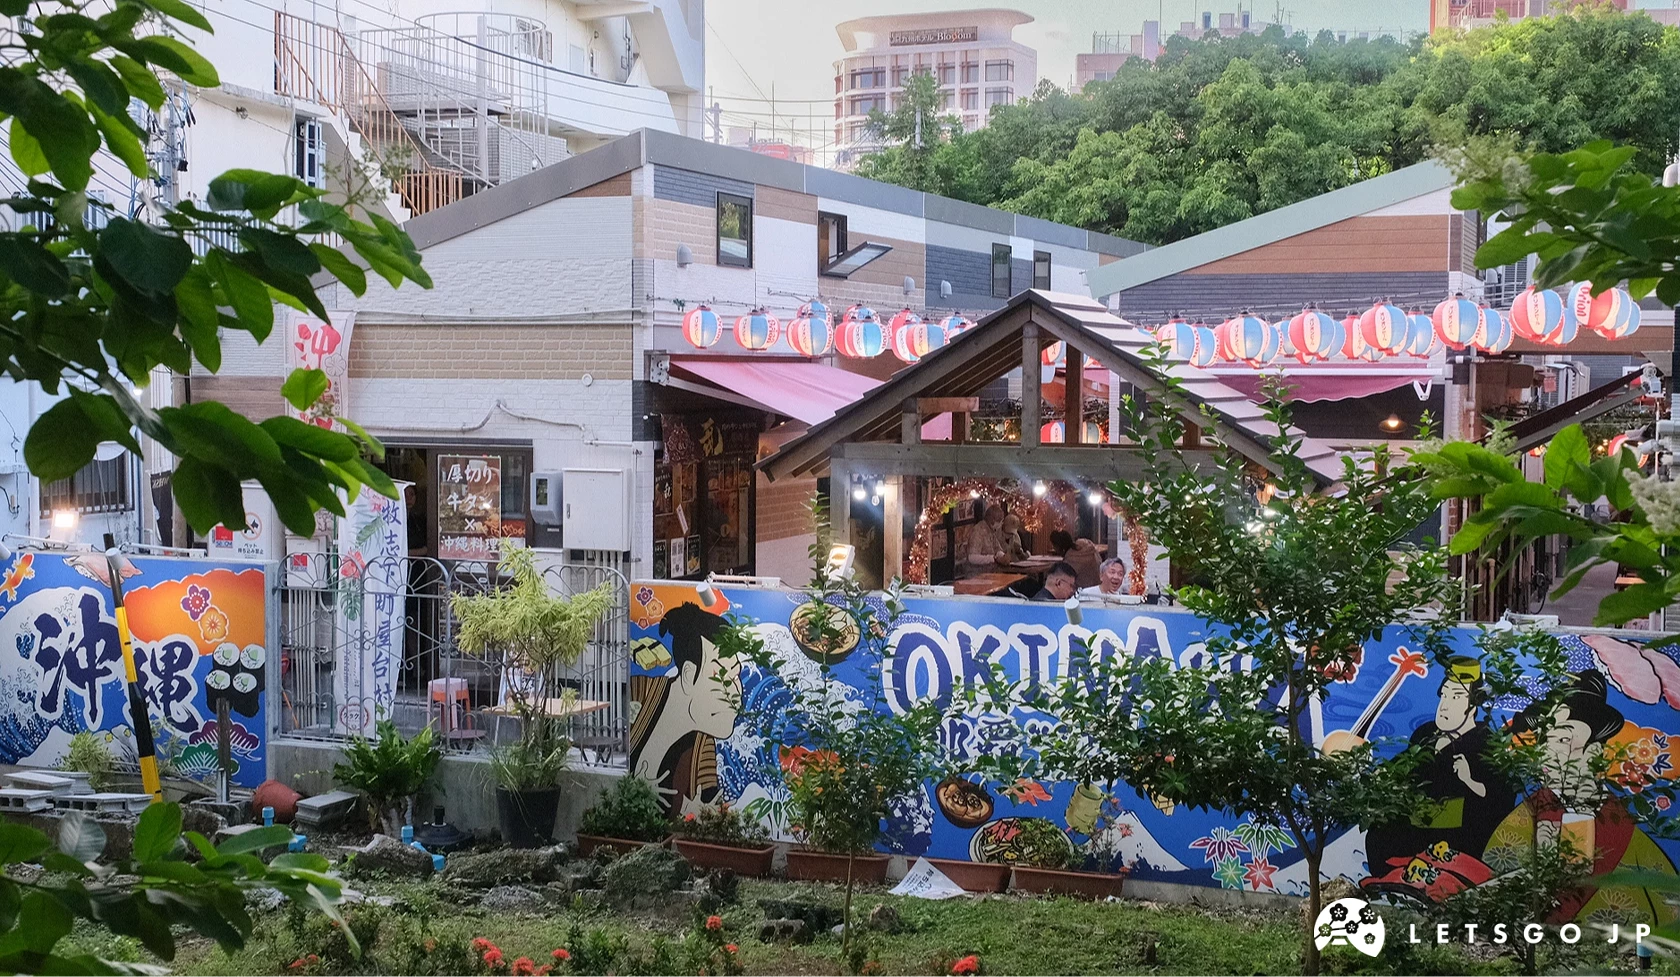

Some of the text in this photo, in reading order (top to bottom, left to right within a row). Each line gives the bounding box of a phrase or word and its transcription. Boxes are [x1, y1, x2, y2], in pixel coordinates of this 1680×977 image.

[447, 463, 493, 484] 厚切り
[446, 492, 493, 512] 牛タン
[440, 535, 500, 554] 沖縄料理
[34, 593, 201, 732] 沖縄
